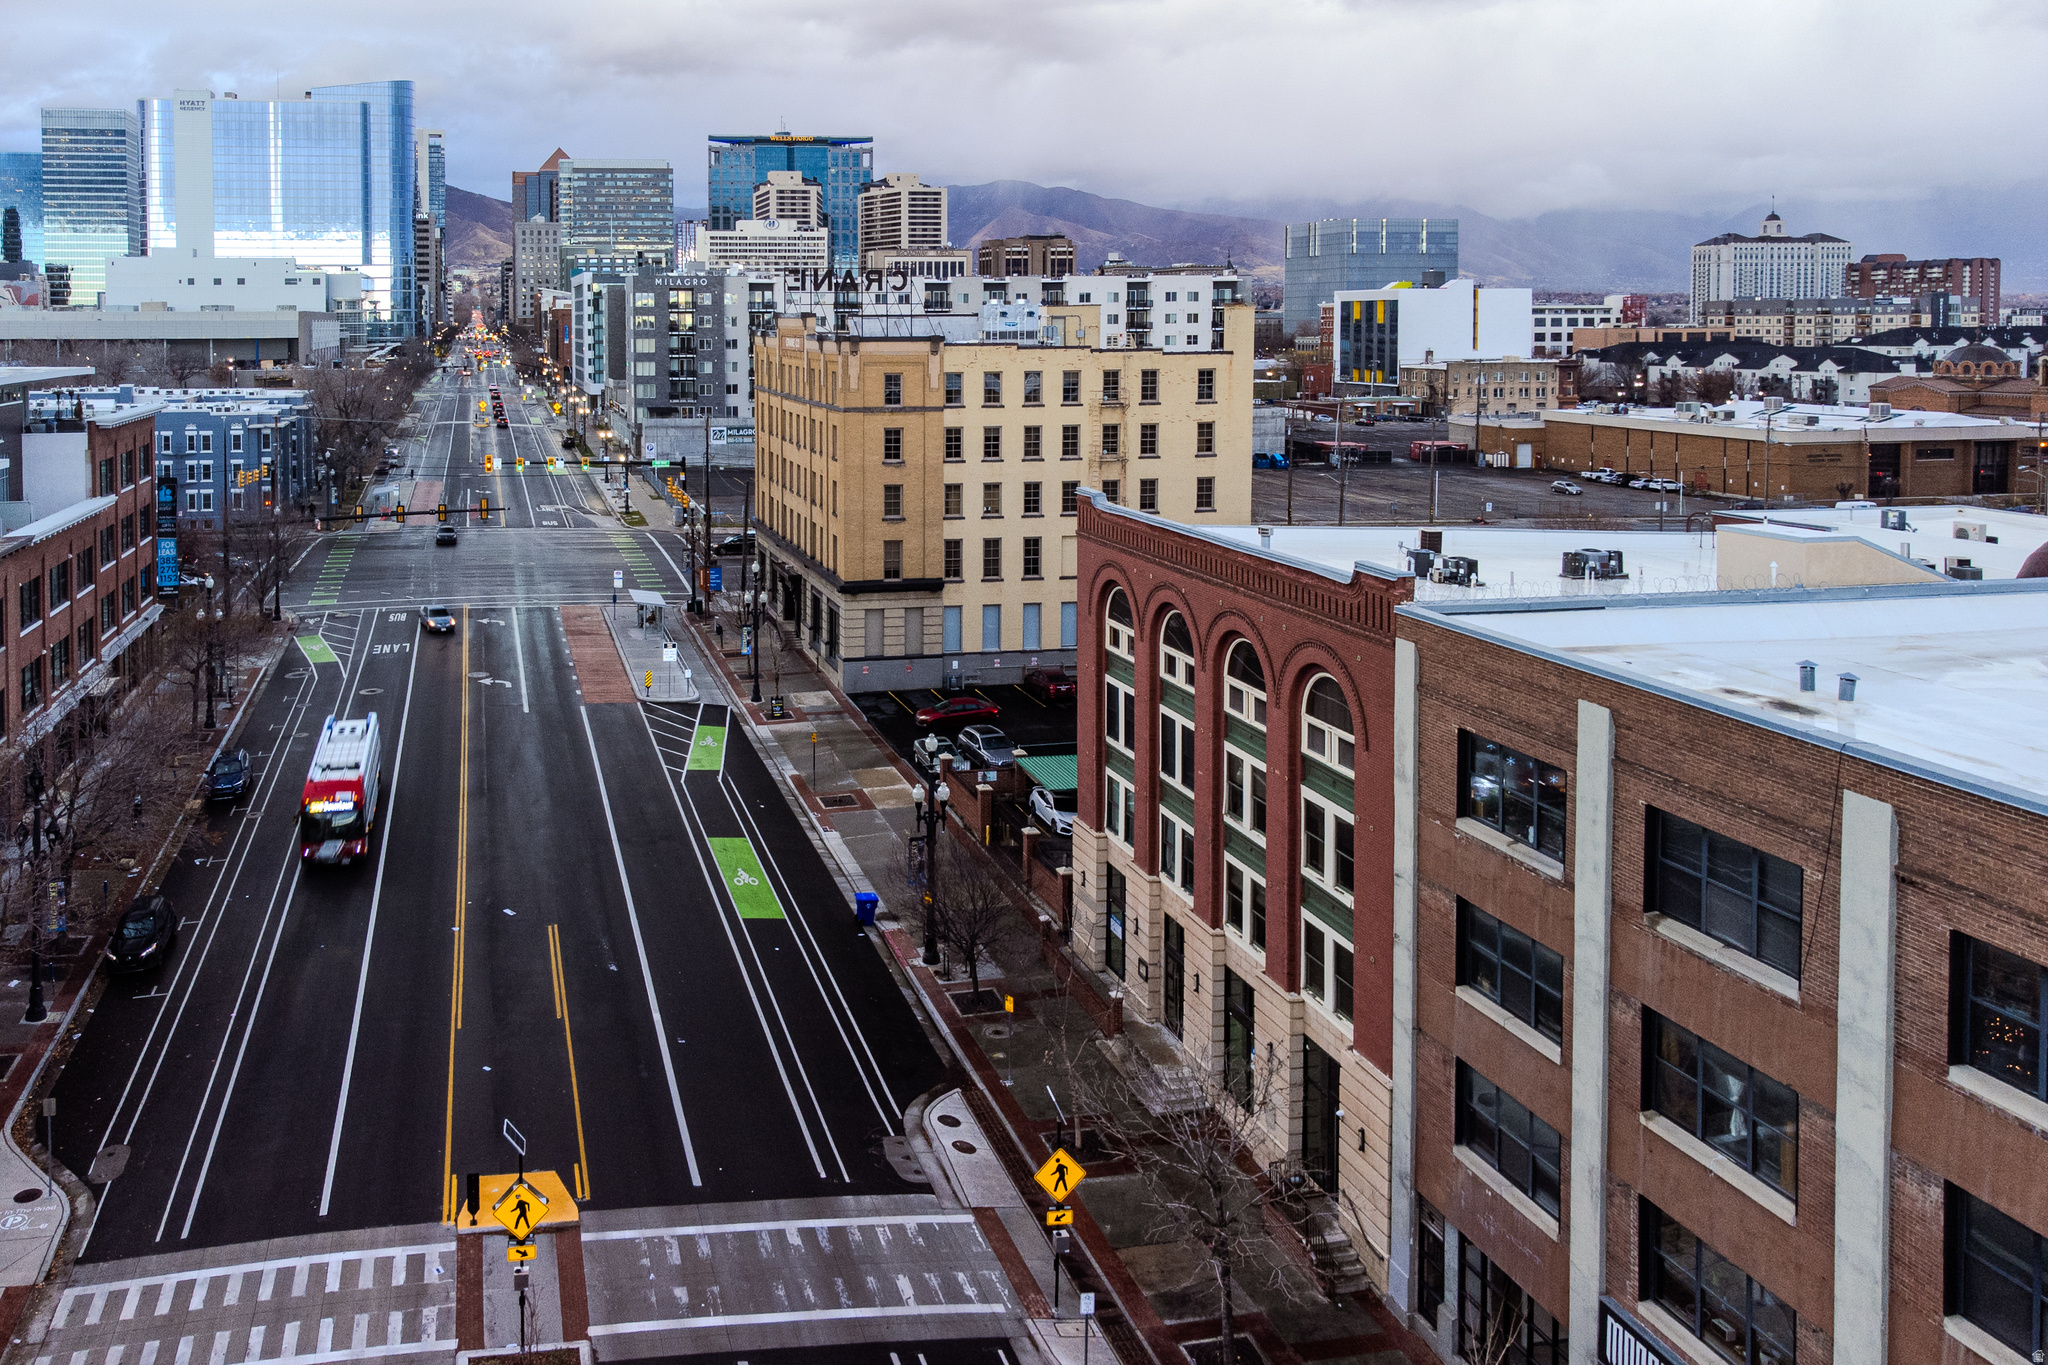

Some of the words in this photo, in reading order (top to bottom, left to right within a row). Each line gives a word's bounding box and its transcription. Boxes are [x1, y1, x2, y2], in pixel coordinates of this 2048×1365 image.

[655, 278, 708, 286] MILAGRO
[160, 557, 177, 565] 385
[160, 574, 178, 582] 1152
[388, 612, 407, 622] BUS
[372, 643, 410, 654] LANE
